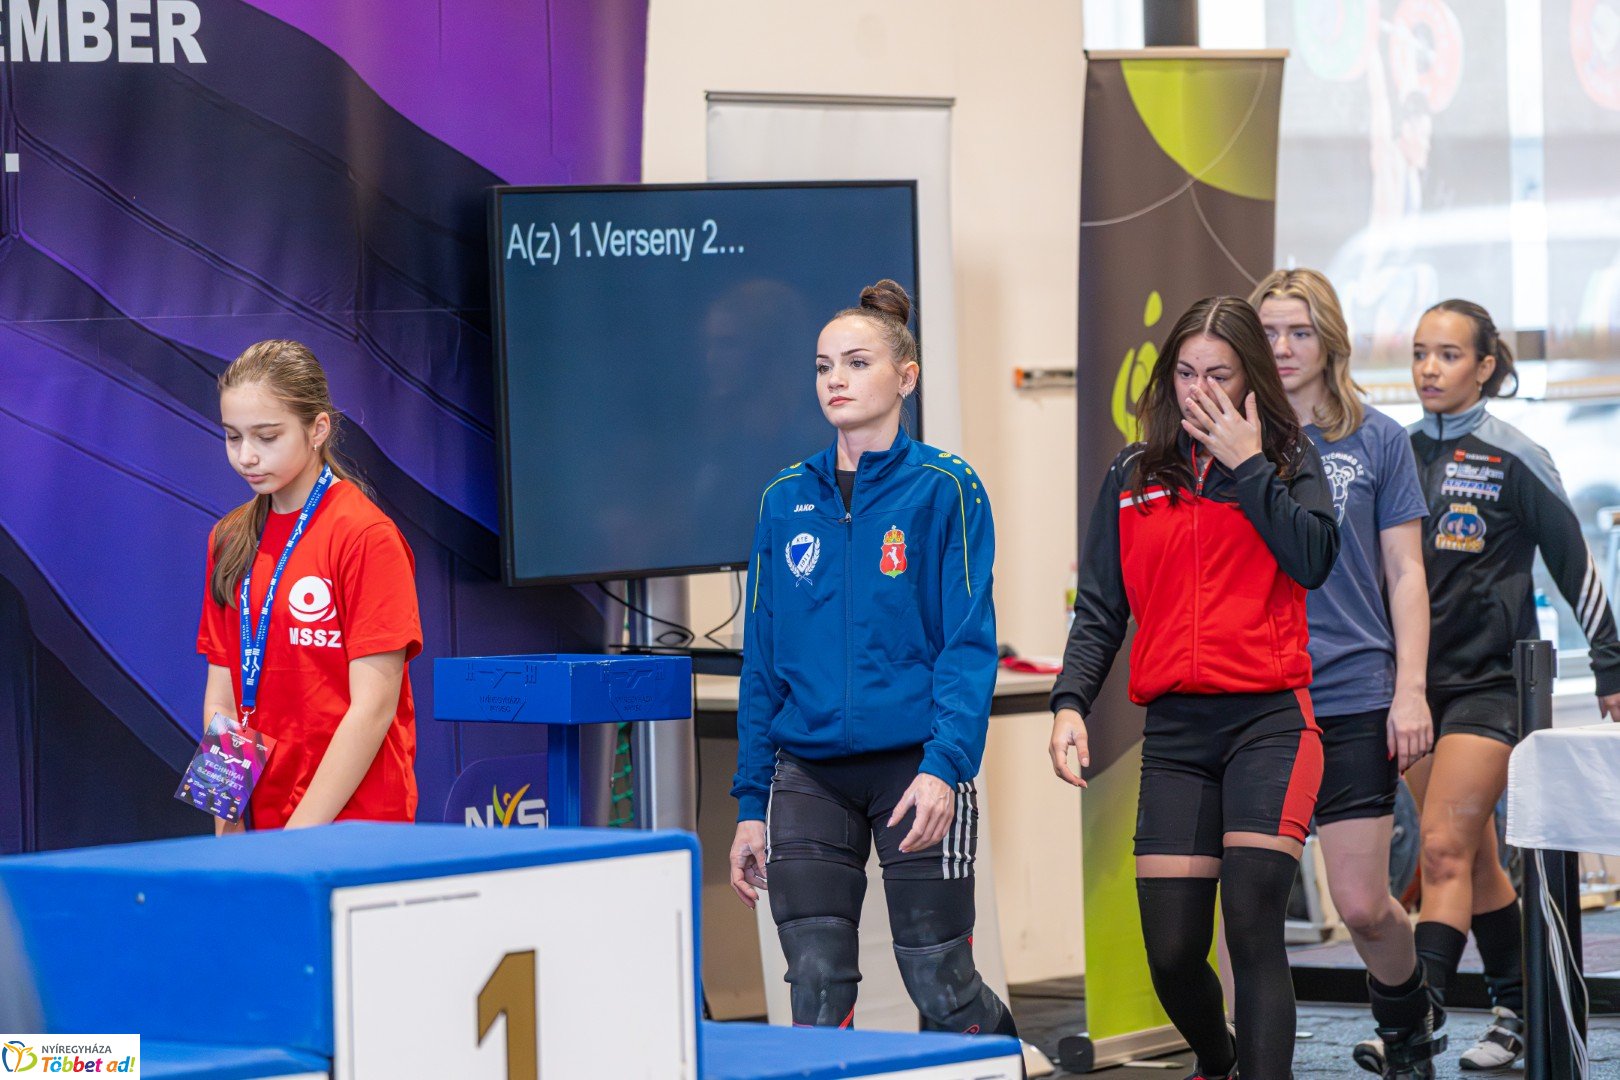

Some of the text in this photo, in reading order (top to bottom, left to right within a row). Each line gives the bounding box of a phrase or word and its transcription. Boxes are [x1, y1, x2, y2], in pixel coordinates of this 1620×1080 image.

[0, 0, 207, 63] MBER
[506, 222, 561, 266] A(z)
[570, 220, 696, 262] 1.Verseny
[793, 503, 815, 513] JAKO
[204, 758, 245, 782] TECHNIKAI
[465, 783, 549, 829] NYS
[477, 949, 539, 1080] 1
